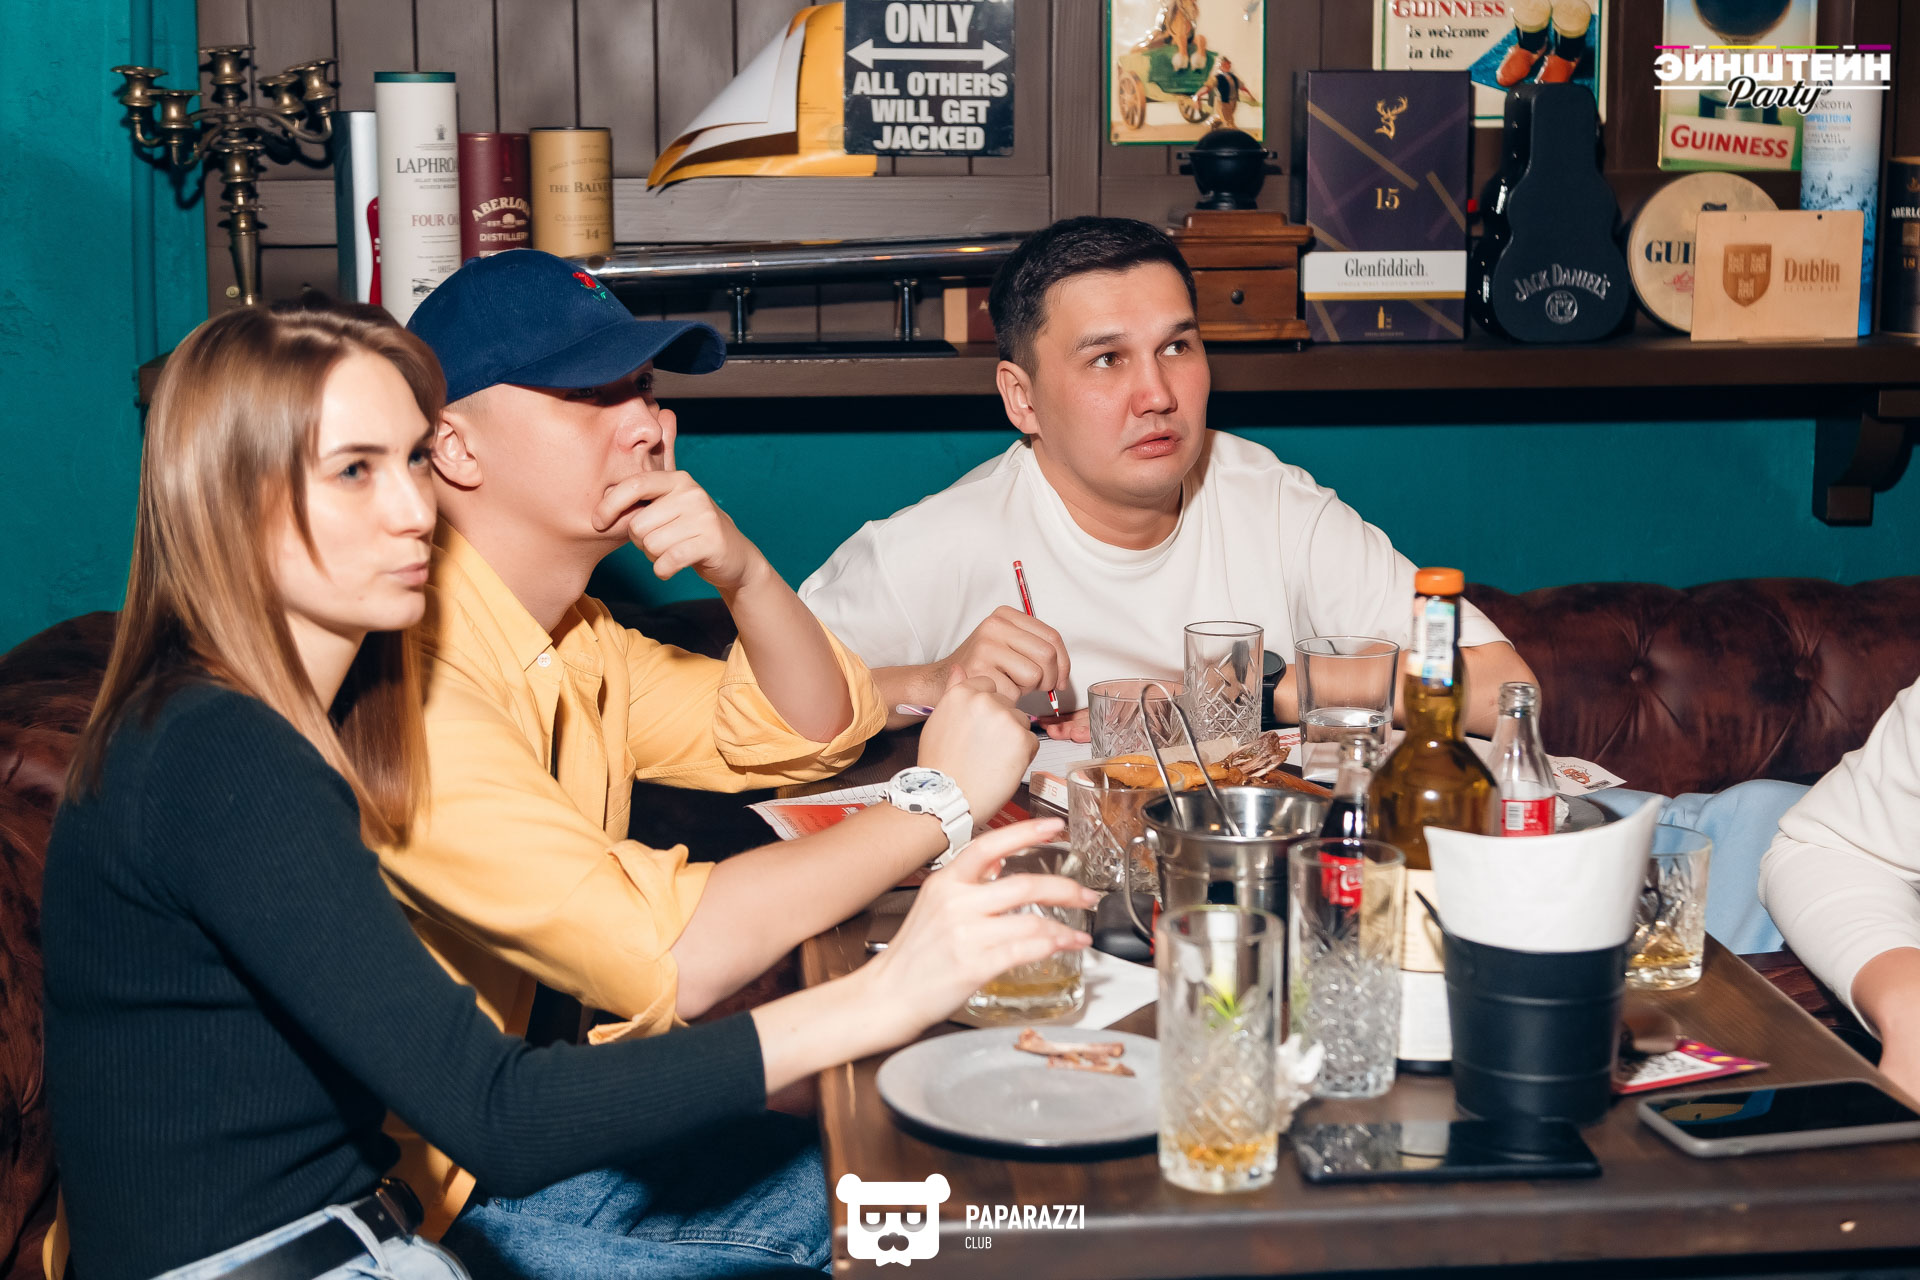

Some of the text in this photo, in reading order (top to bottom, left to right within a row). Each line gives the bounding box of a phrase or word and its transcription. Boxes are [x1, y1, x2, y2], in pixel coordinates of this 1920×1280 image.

[884, 2, 975, 44] ONLY
[1428, 25, 1490, 38] welcome
[1430, 46, 1454, 59] the
[852, 71, 1009, 98] ALL OTHERS
[871, 98, 991, 125] WILL GET
[872, 125, 985, 150] JACKED
[1670, 125, 1789, 160] GUINNESS
[1375, 187, 1400, 211] 15
[412, 214, 445, 227] FOUR
[1645, 240, 1695, 264] GUI
[1345, 258, 1425, 278] Glenfiddich
[1784, 257, 1841, 284] Dublin
[1514, 270, 1550, 302] JACK
